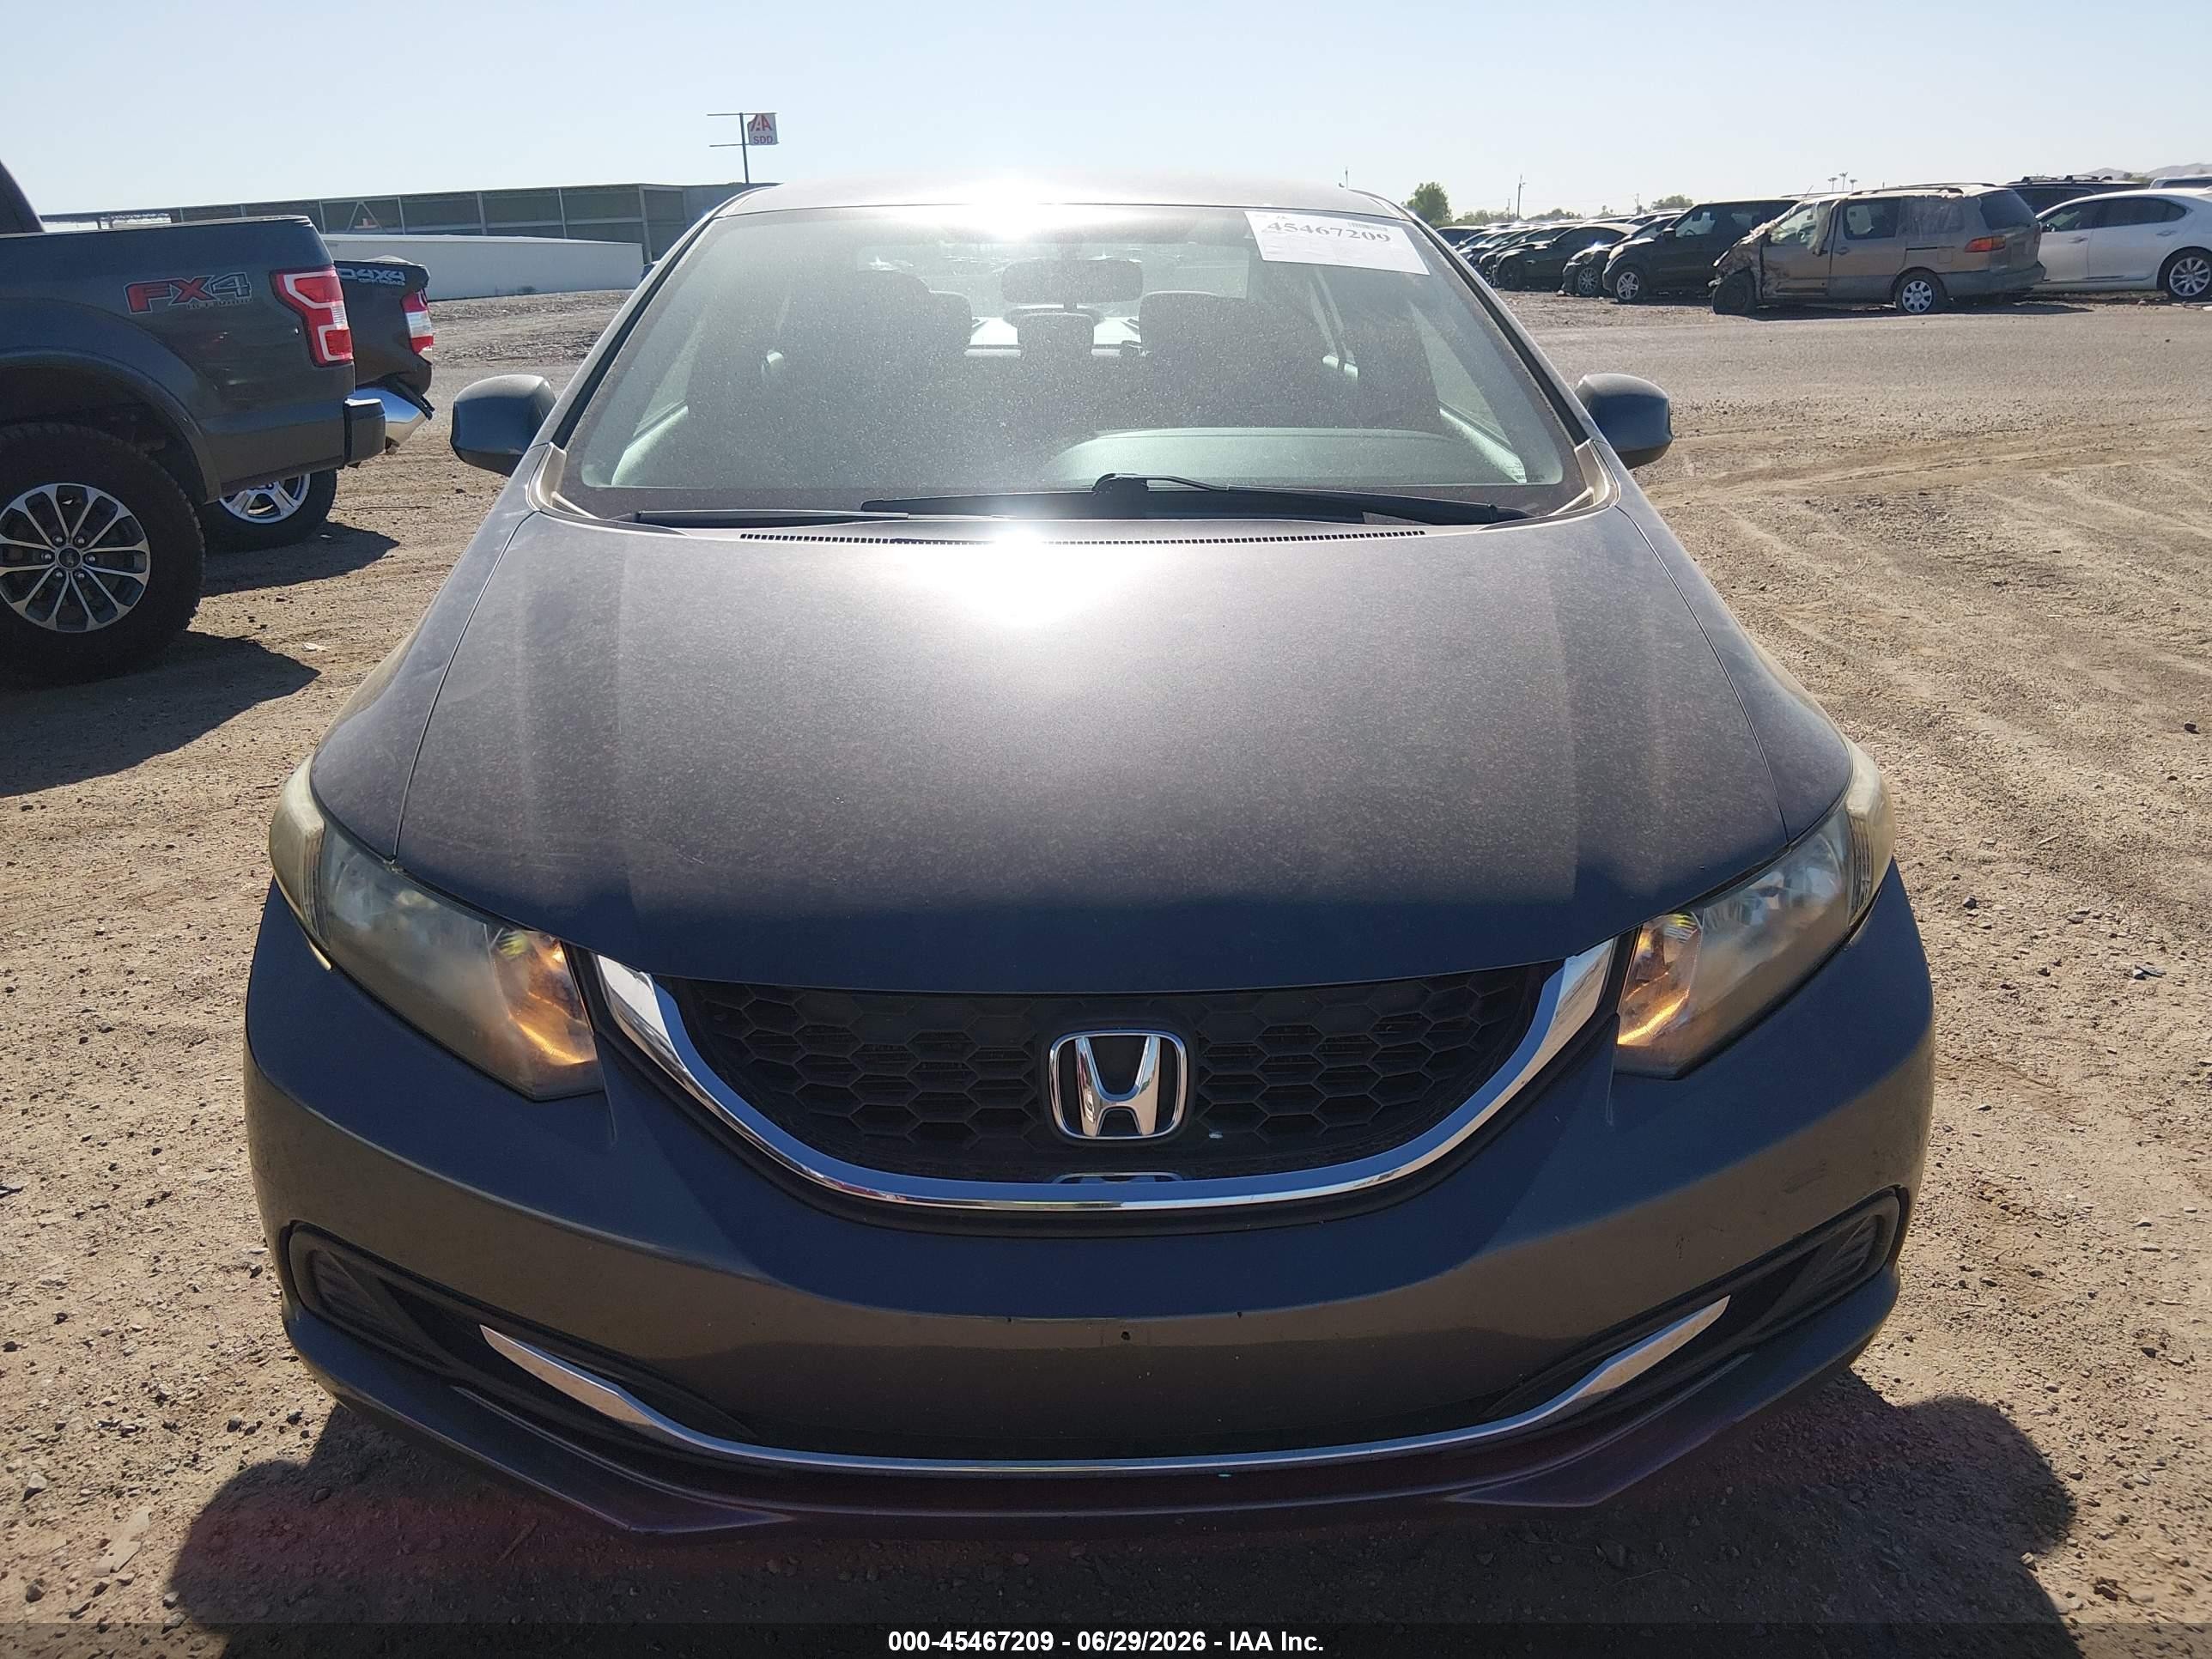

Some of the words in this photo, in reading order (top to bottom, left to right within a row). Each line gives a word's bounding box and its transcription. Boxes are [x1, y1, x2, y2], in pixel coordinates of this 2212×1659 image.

[753, 136, 774, 144] SDD
[1267, 222, 1392, 242] 45467209
[124, 272, 252, 314] FX4
